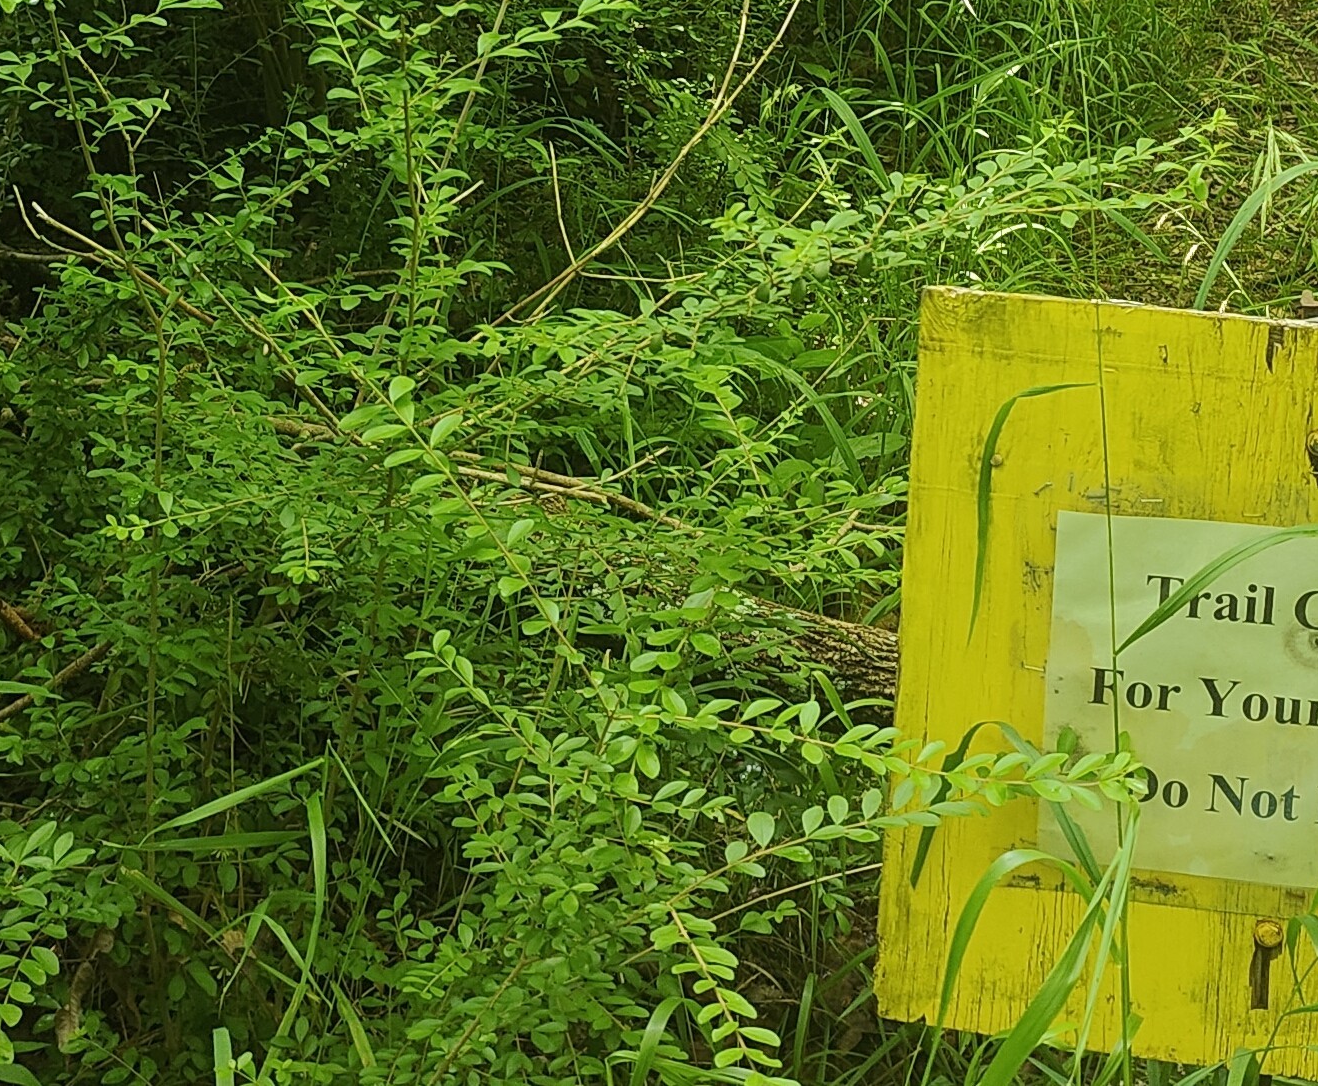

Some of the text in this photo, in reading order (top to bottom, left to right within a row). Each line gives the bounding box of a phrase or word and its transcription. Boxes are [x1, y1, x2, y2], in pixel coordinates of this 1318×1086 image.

[1146, 574, 1275, 626] Trail
[1087, 666, 1182, 711] For
[1204, 773, 1300, 822] Not
